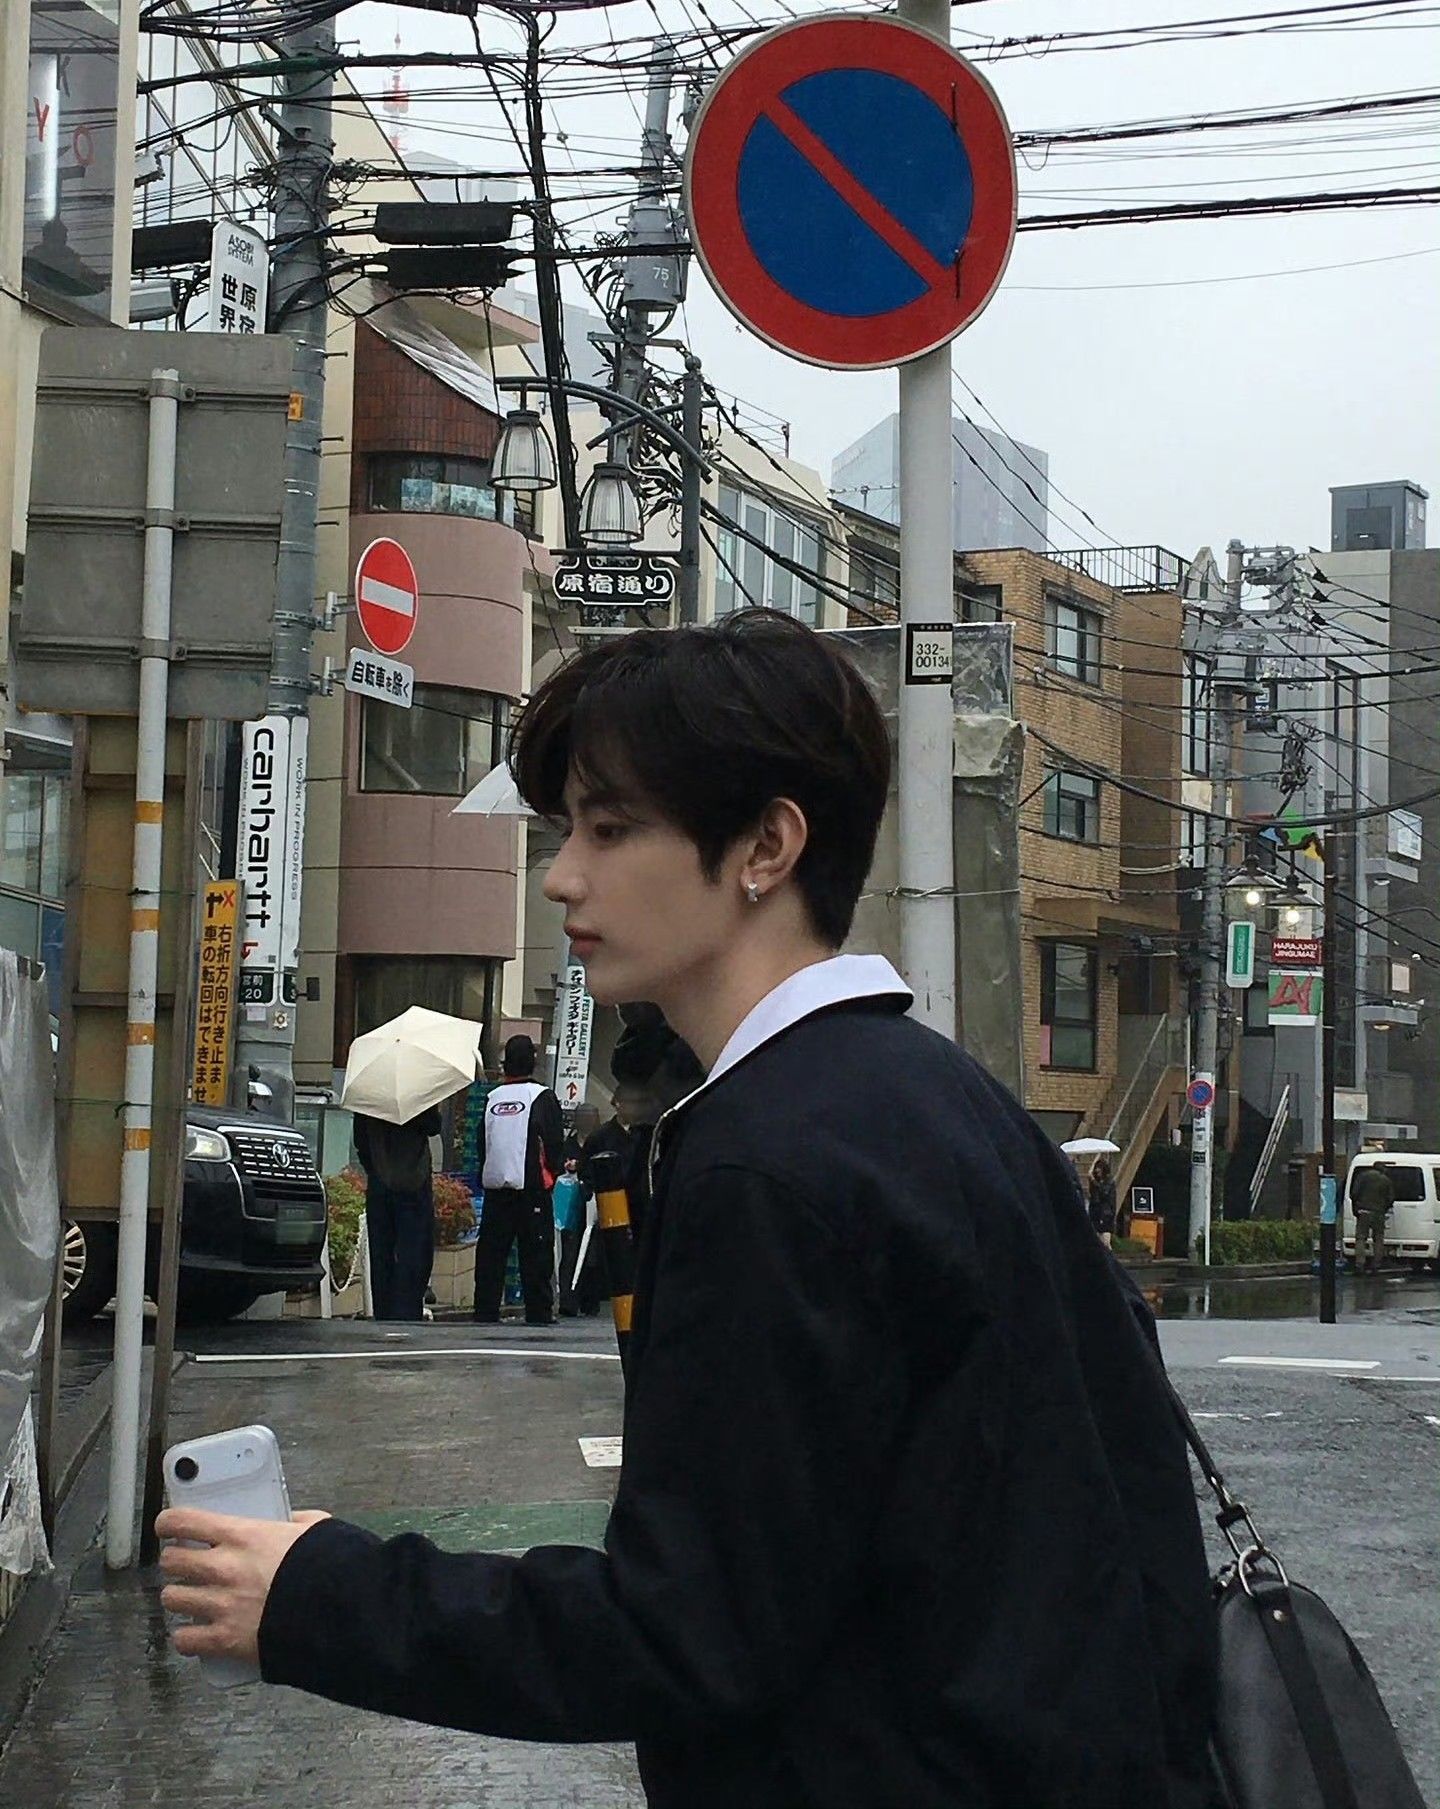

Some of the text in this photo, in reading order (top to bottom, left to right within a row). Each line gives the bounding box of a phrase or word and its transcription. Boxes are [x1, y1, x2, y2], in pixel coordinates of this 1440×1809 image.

[228, 234, 254, 255] ASOBI
[227, 246, 254, 267] SYSTEM
[652, 266, 670, 281] 75
[219, 273, 238, 334] 世界
[559, 573, 671, 595] 原宿通り
[916, 643, 945, 656] 332-
[351, 660, 410, 698] 自転車を除く
[245, 727, 276, 928] carhartt
[290, 757, 304, 900] WORK IN PROGRESS
[1273, 941, 1317, 952] HARAJUKU
[1275, 949, 1316, 959] JINGUMAE
[245, 988, 262, 999] 20
